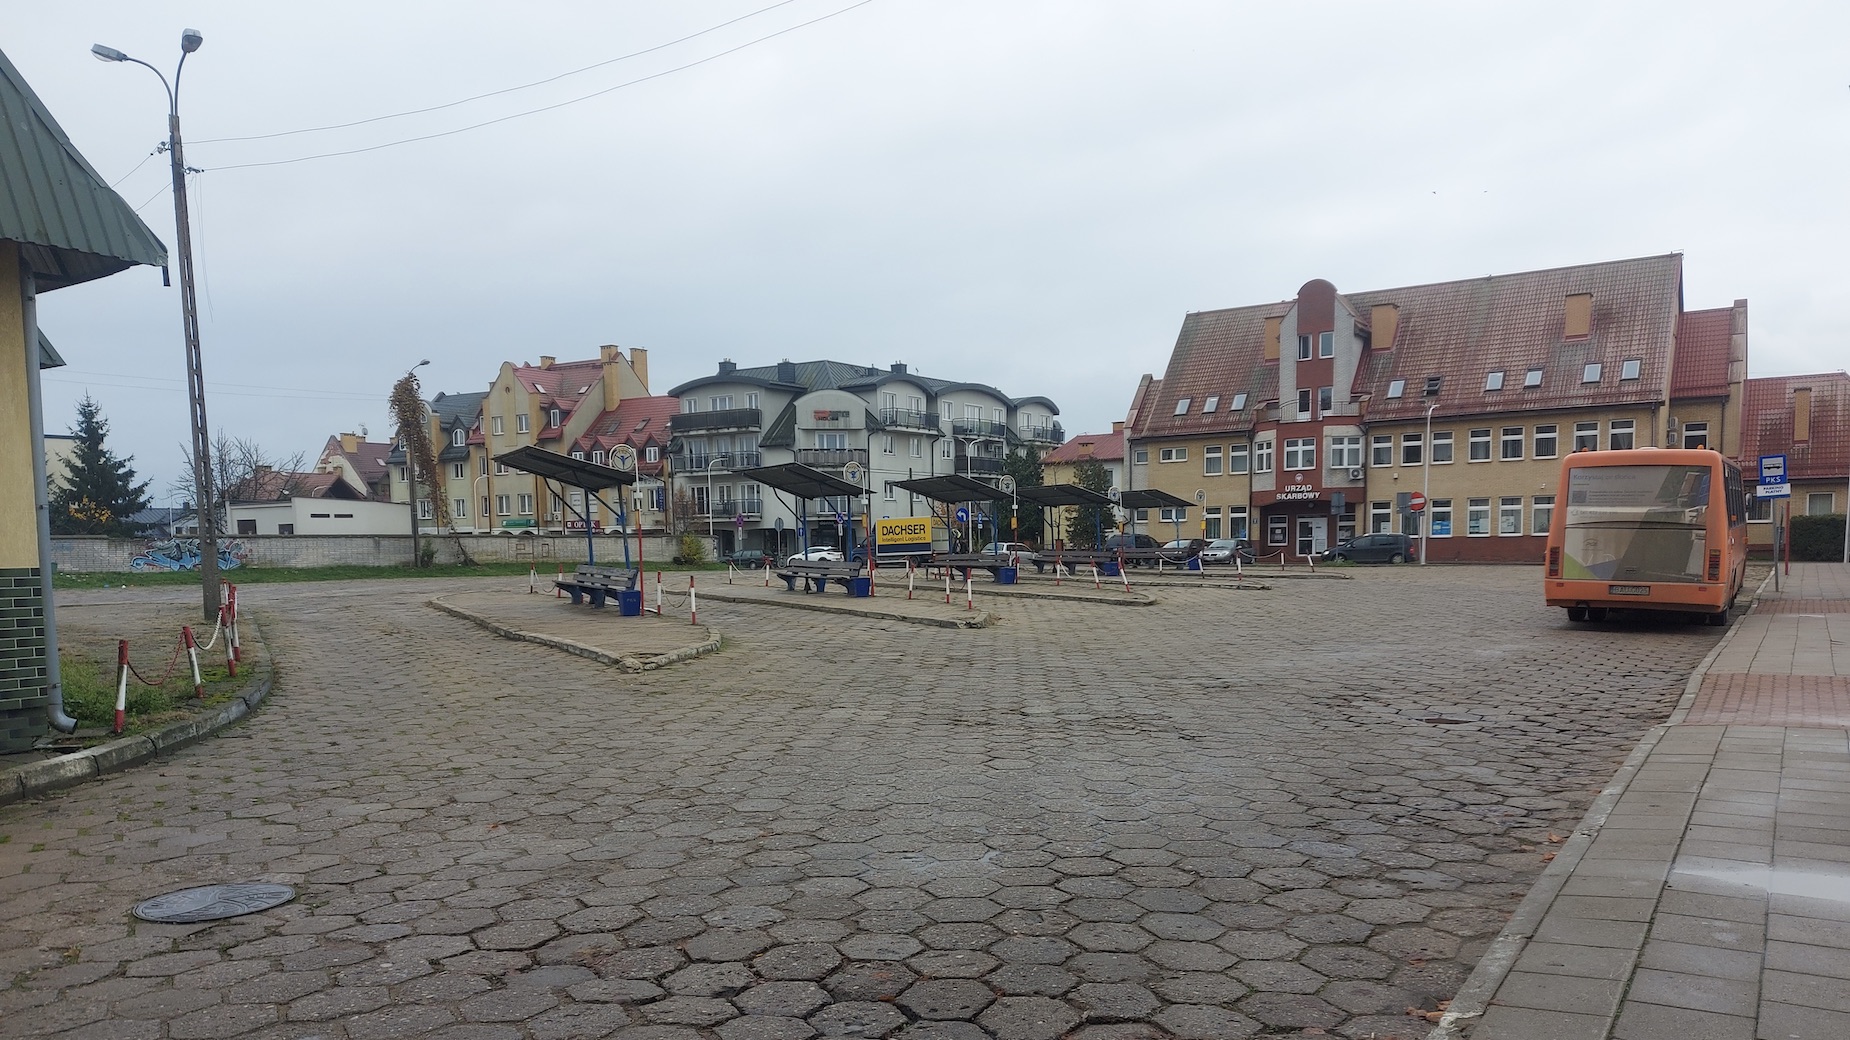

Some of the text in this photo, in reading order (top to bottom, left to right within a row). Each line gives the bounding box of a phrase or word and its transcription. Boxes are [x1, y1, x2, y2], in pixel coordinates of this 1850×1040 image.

[1284, 484, 1313, 492] URZĄD
[1276, 492, 1321, 500] SKARBOWY
[881, 524, 926, 536] DACHSER
